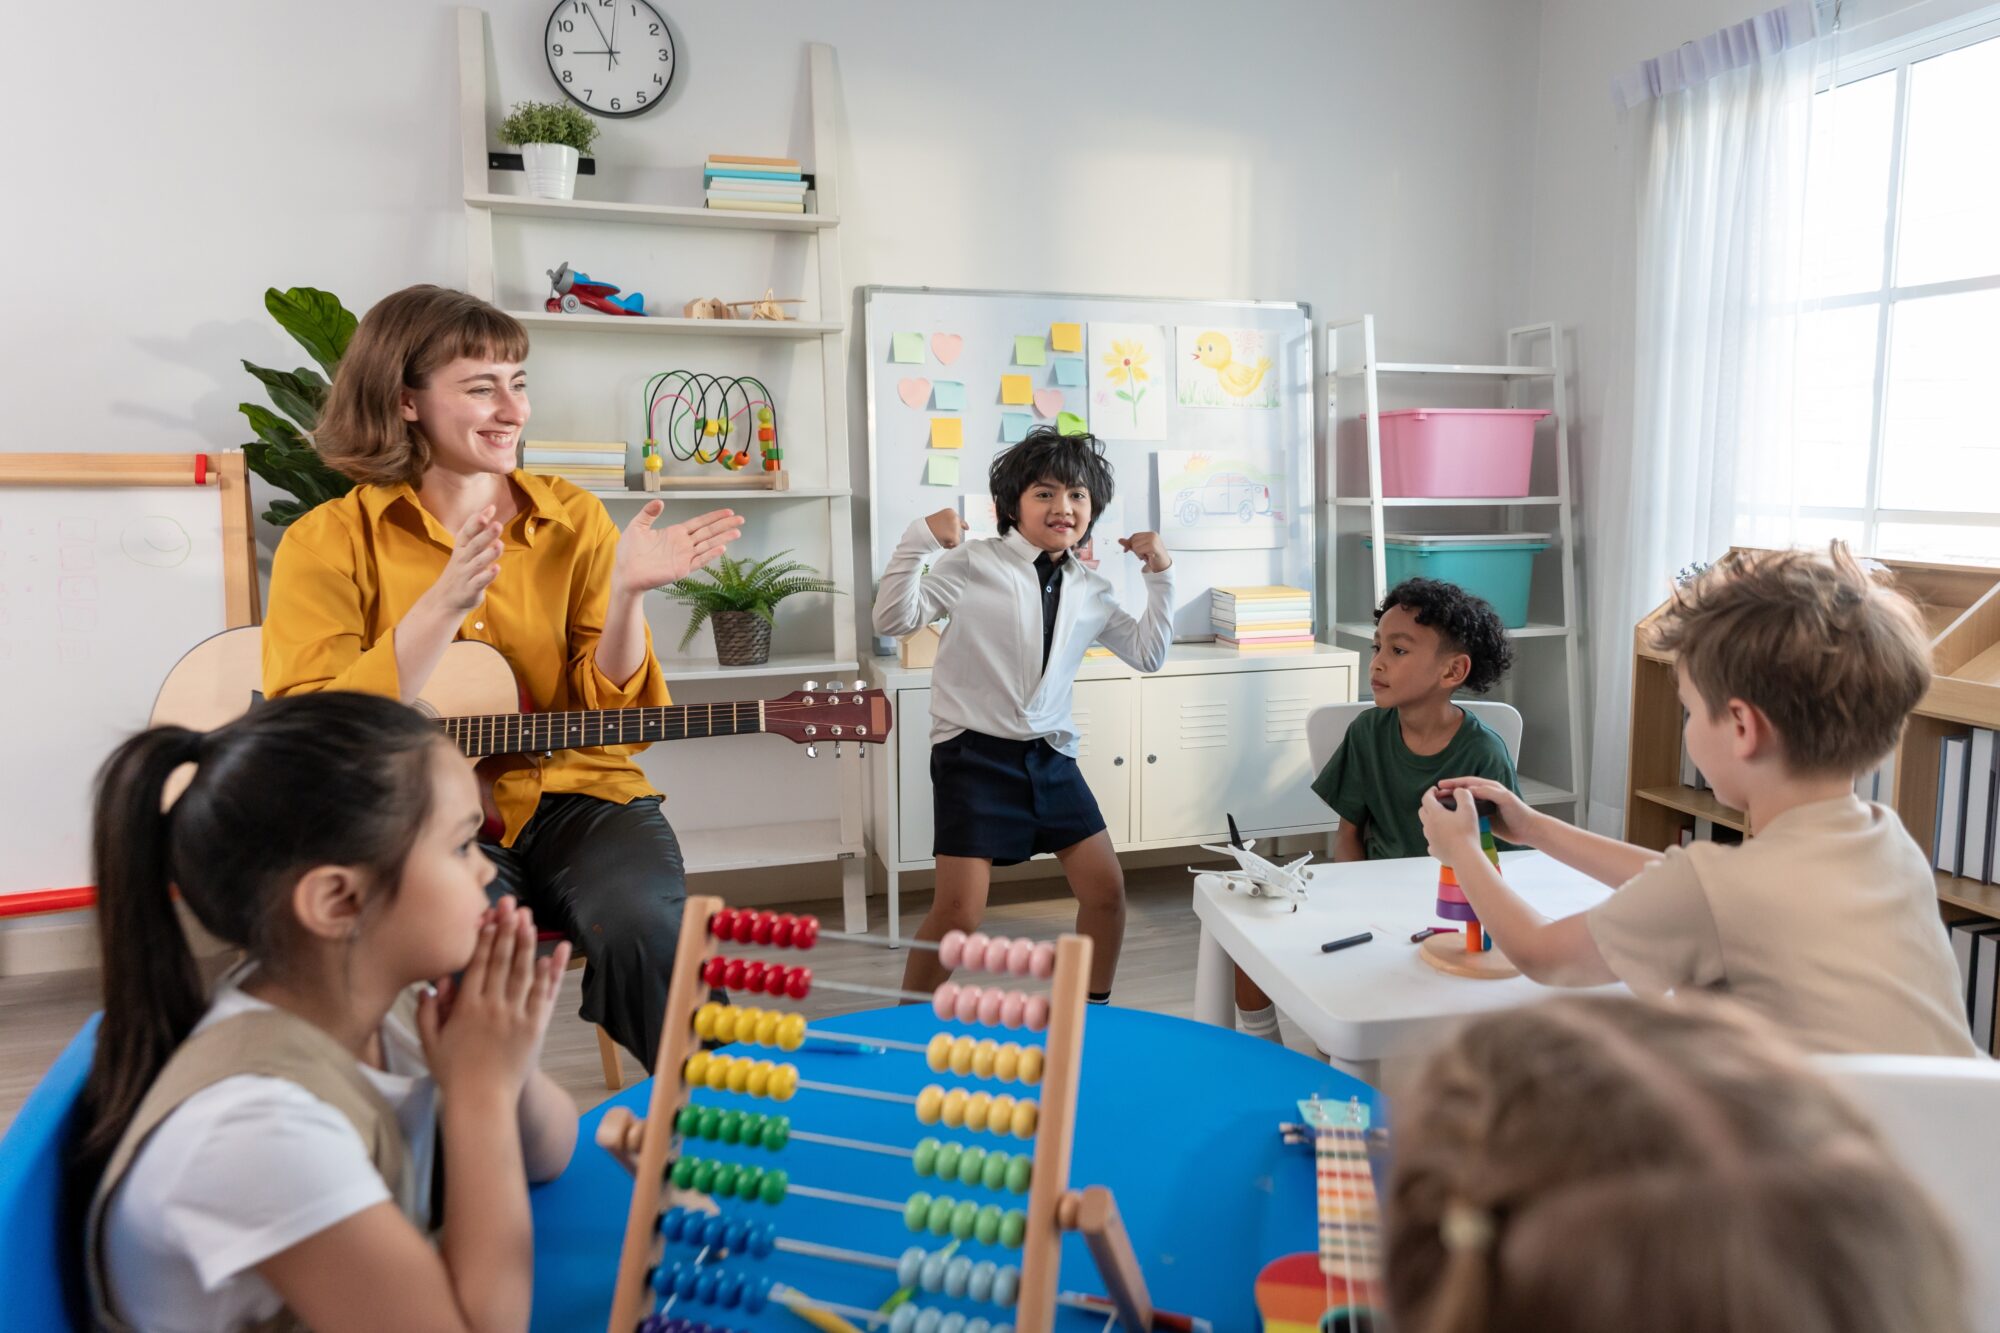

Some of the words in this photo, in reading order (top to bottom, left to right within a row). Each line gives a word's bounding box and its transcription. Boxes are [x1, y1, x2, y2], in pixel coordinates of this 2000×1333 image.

[572, 1, 587, 14] 11
[631, 4, 637, 17] 1
[557, 19, 574, 33] 10
[648, 23, 660, 36] 2
[552, 44, 564, 57] 9
[658, 48, 669, 62] 3
[562, 70, 573, 83] 8
[653, 73, 663, 86] 4
[583, 89, 593, 102] 7
[636, 91, 647, 104] 5
[610, 98, 621, 111] 6
